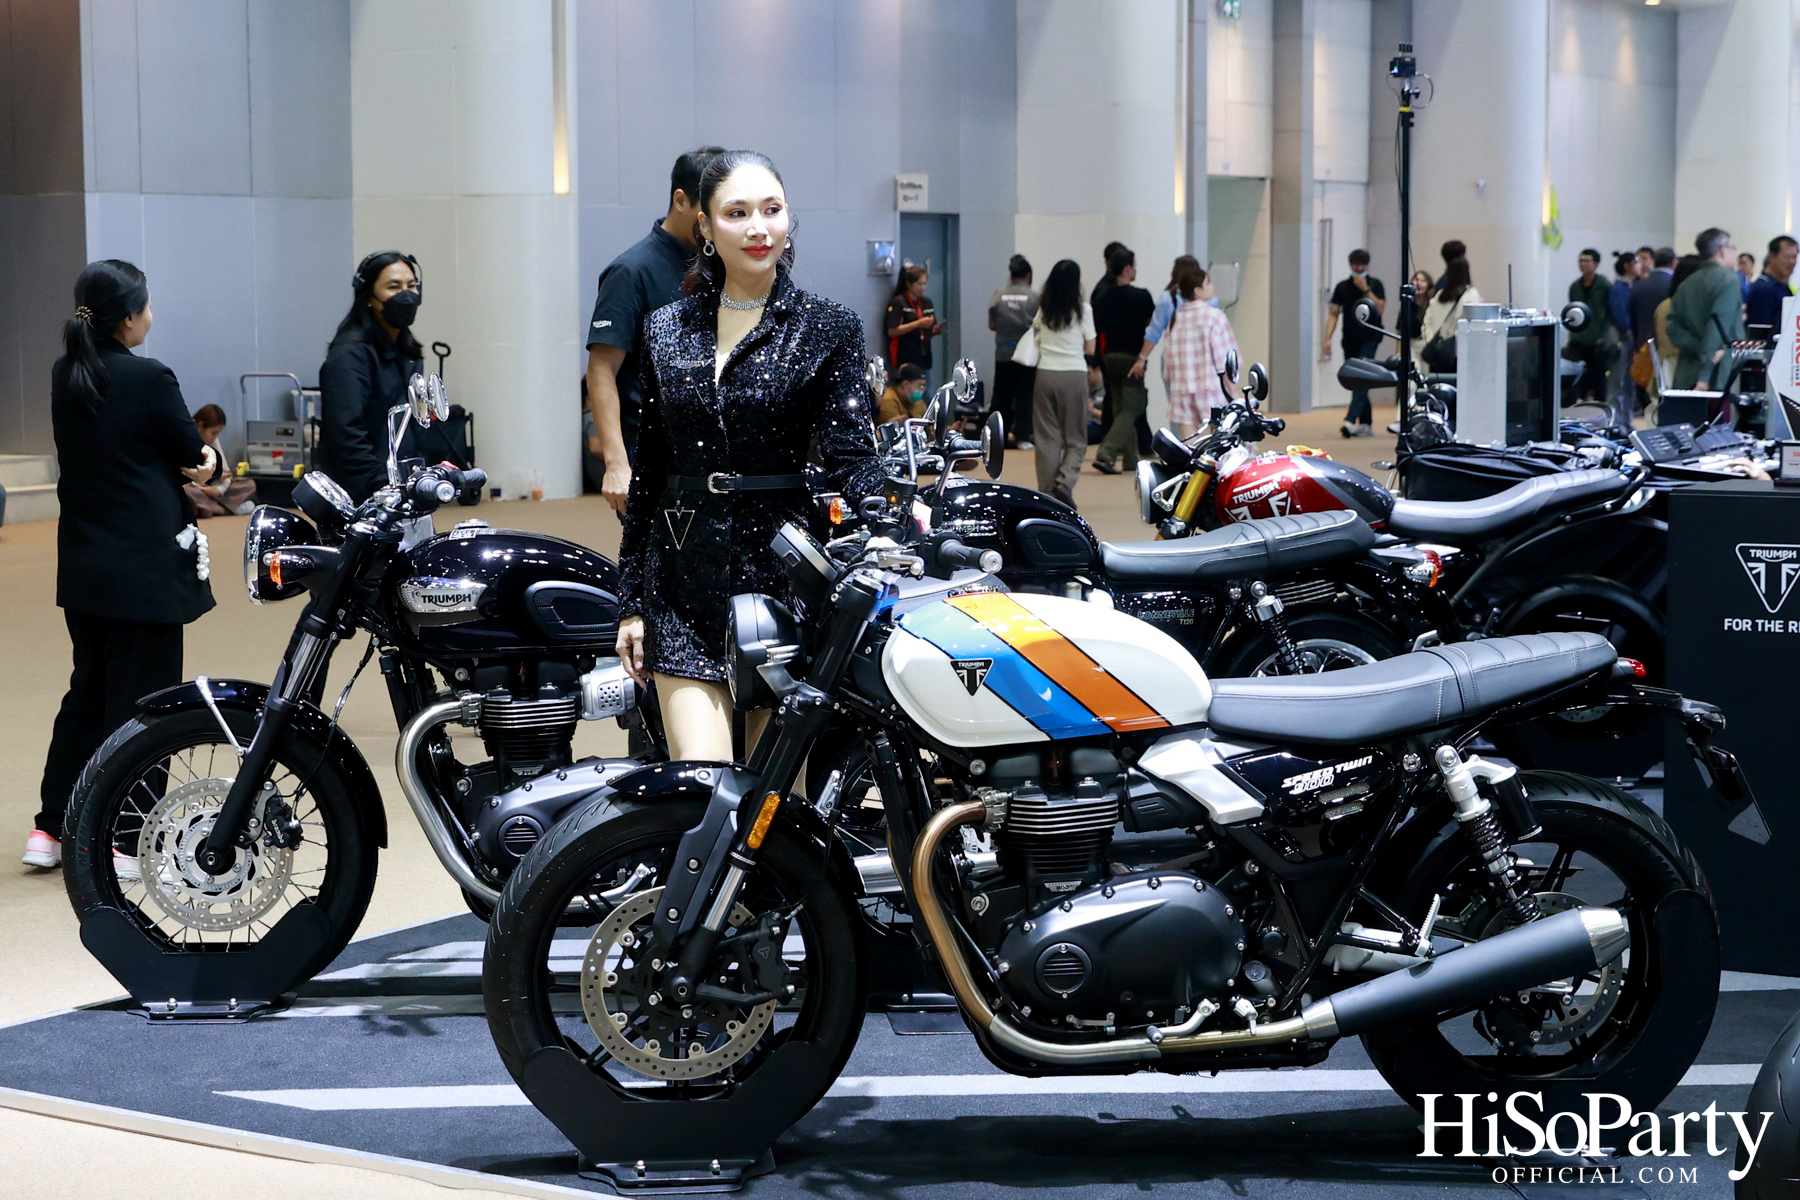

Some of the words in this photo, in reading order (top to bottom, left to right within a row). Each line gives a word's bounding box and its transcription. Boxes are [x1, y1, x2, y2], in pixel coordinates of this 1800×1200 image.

[1232, 480, 1280, 504] TRIUMPH
[1749, 549, 1797, 562] TRIUMPH
[421, 593, 472, 607] TRIUMPH
[1137, 608, 1196, 620] BONNEVILLE
[1180, 618, 1195, 626] T120
[1724, 618, 1753, 631] FOR
[1755, 619, 1785, 633] THE
[958, 661, 985, 669] TRIUMPH
[1281, 766, 1334, 788] SPEED
[1335, 755, 1373, 774] TWIN
[1289, 774, 1335, 795] 900
